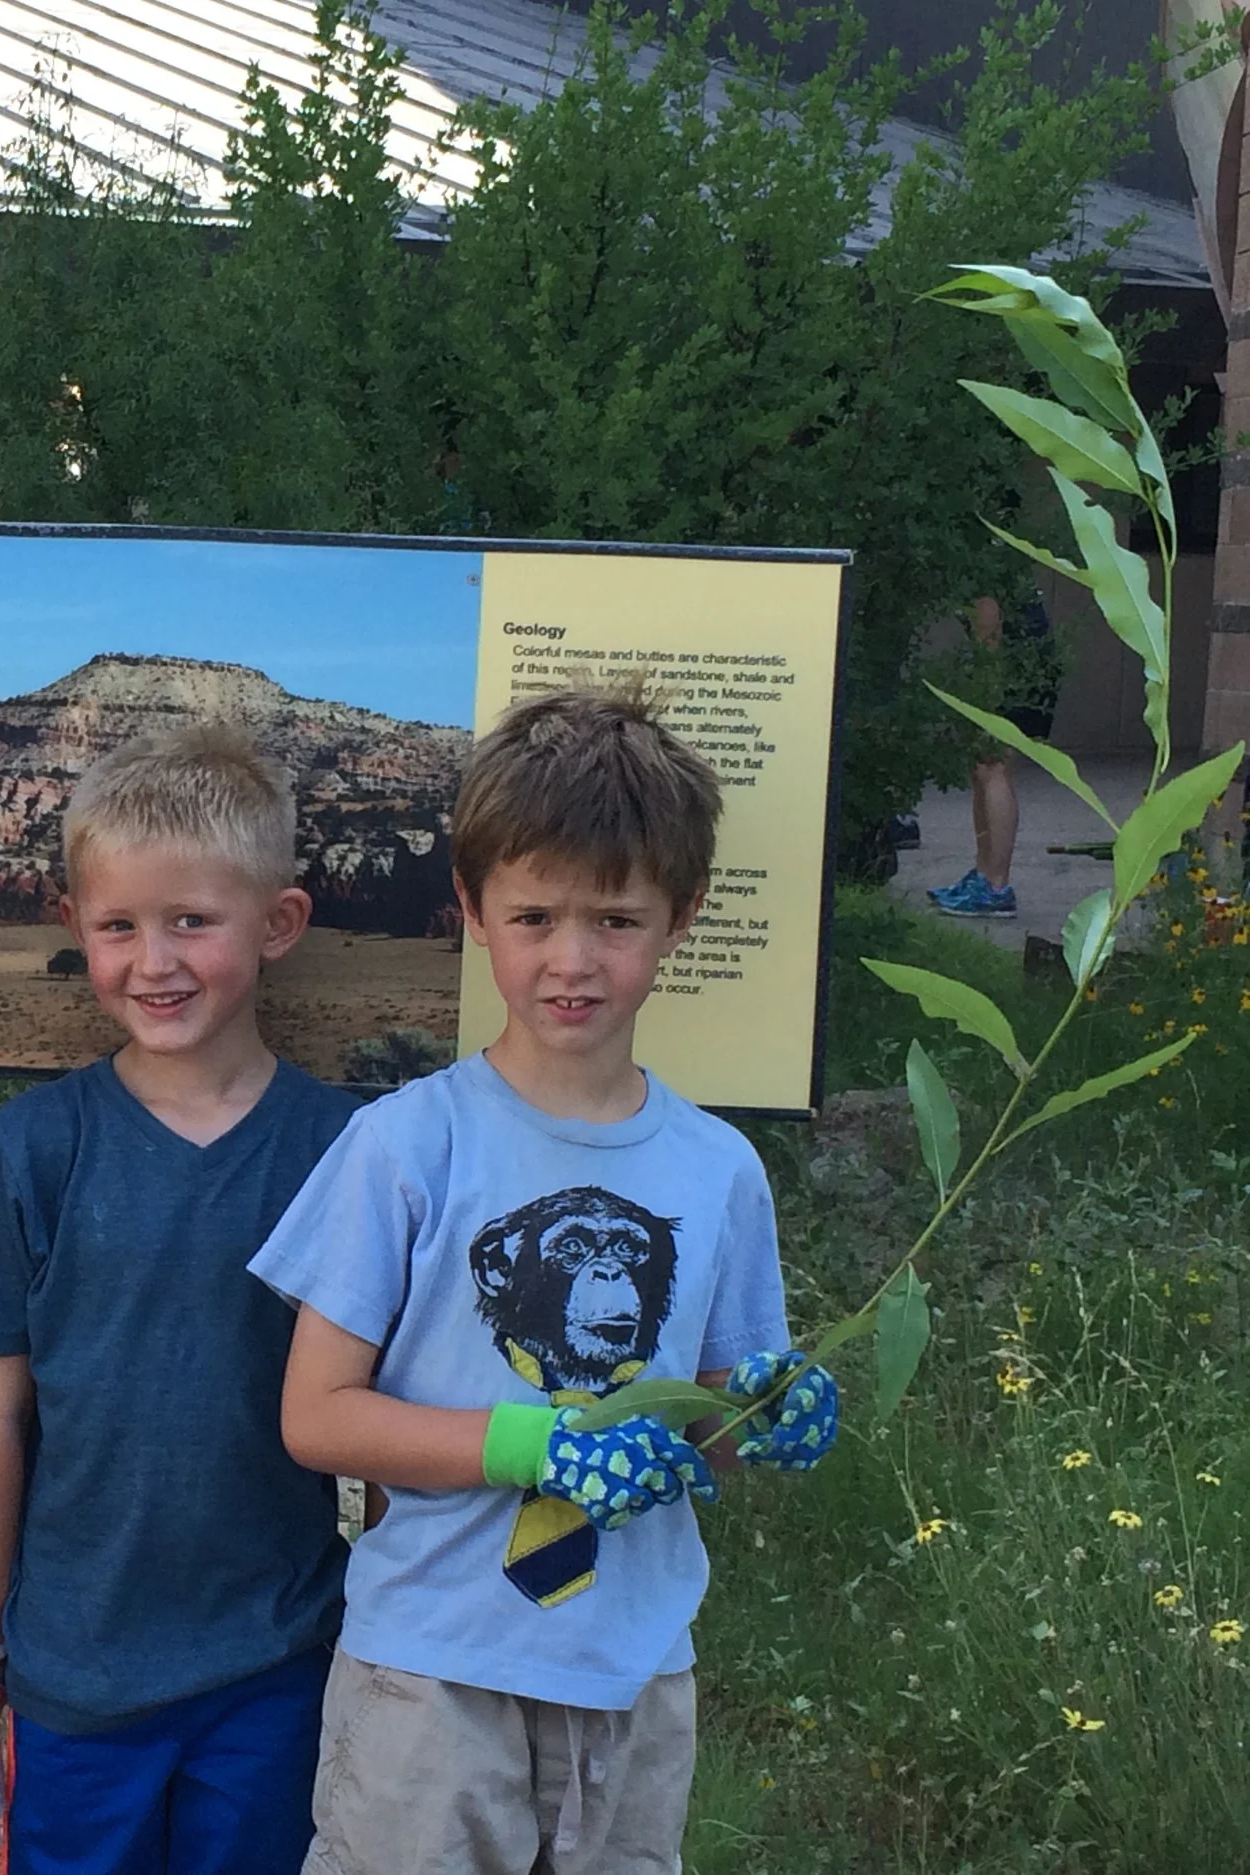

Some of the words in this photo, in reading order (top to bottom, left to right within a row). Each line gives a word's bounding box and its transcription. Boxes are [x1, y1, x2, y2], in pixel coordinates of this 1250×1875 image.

[503, 622, 567, 640] Geology
[513, 645, 561, 658] Colorful
[564, 649, 606, 660] mesas
[609, 650, 633, 661] and
[636, 651, 675, 663] buttes
[678, 653, 699, 664] are
[702, 654, 787, 667] characteristic
[511, 663, 524, 674] of
[527, 663, 550, 675] this
[660, 670, 729, 683] sandstone,
[733, 672, 767, 684] shale
[770, 674, 796, 685] and
[698, 687, 718, 699] the
[721, 688, 782, 701] Mesozoic
[673, 704, 706, 716] when
[710, 706, 749, 719] rivers,
[696, 722, 763, 738] alternately
[688, 739, 751, 753] olcanoes,
[753, 741, 776, 753] like
[720, 758, 740, 769] the
[743, 758, 763, 769] flat
[725, 868, 768, 879] across
[714, 882, 758, 897] always
[748, 918, 769, 930] but
[700, 935, 768, 949] completely
[675, 949, 695, 960] the
[698, 952, 727, 962] area
[730, 951, 741, 962] is
[672, 966, 693, 977] but
[695, 967, 743, 980] riparian
[665, 984, 704, 995] occur.
